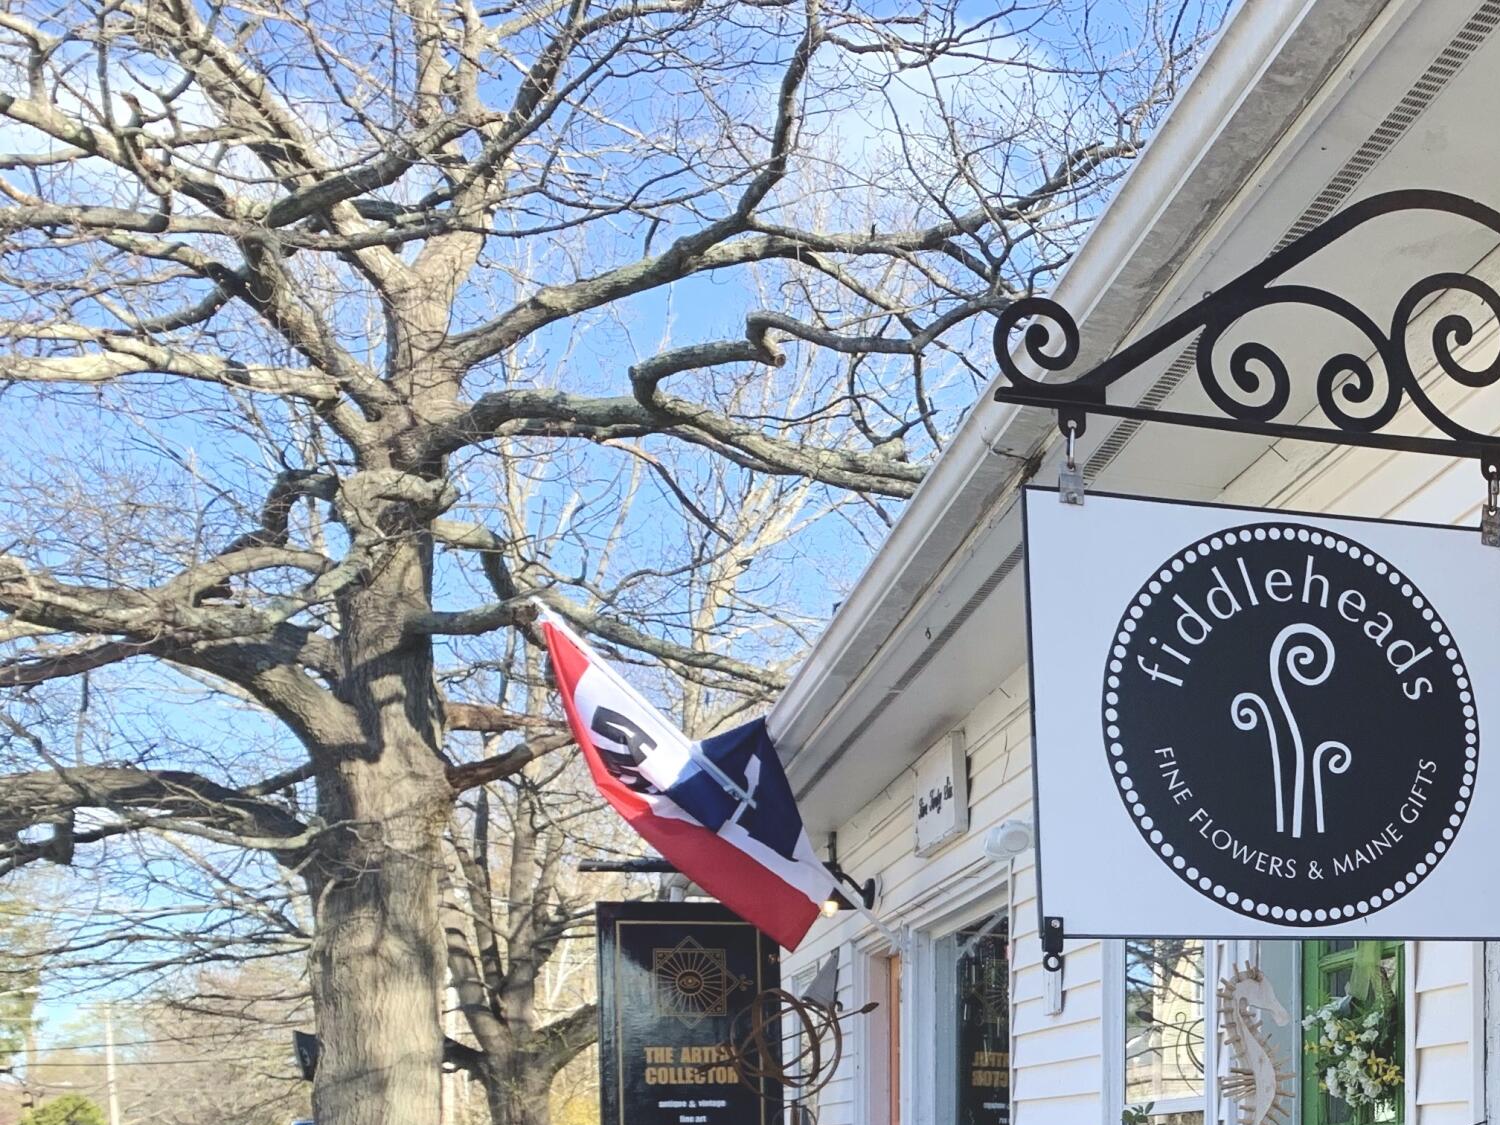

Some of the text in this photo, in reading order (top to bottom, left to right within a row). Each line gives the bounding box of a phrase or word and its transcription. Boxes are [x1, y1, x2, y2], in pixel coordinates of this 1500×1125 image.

[1138, 555, 1433, 700] fiddleheads
[1154, 747, 1437, 879] FINE FLOWERS & MAINE GIFTS
[643, 1046, 673, 1064] THE
